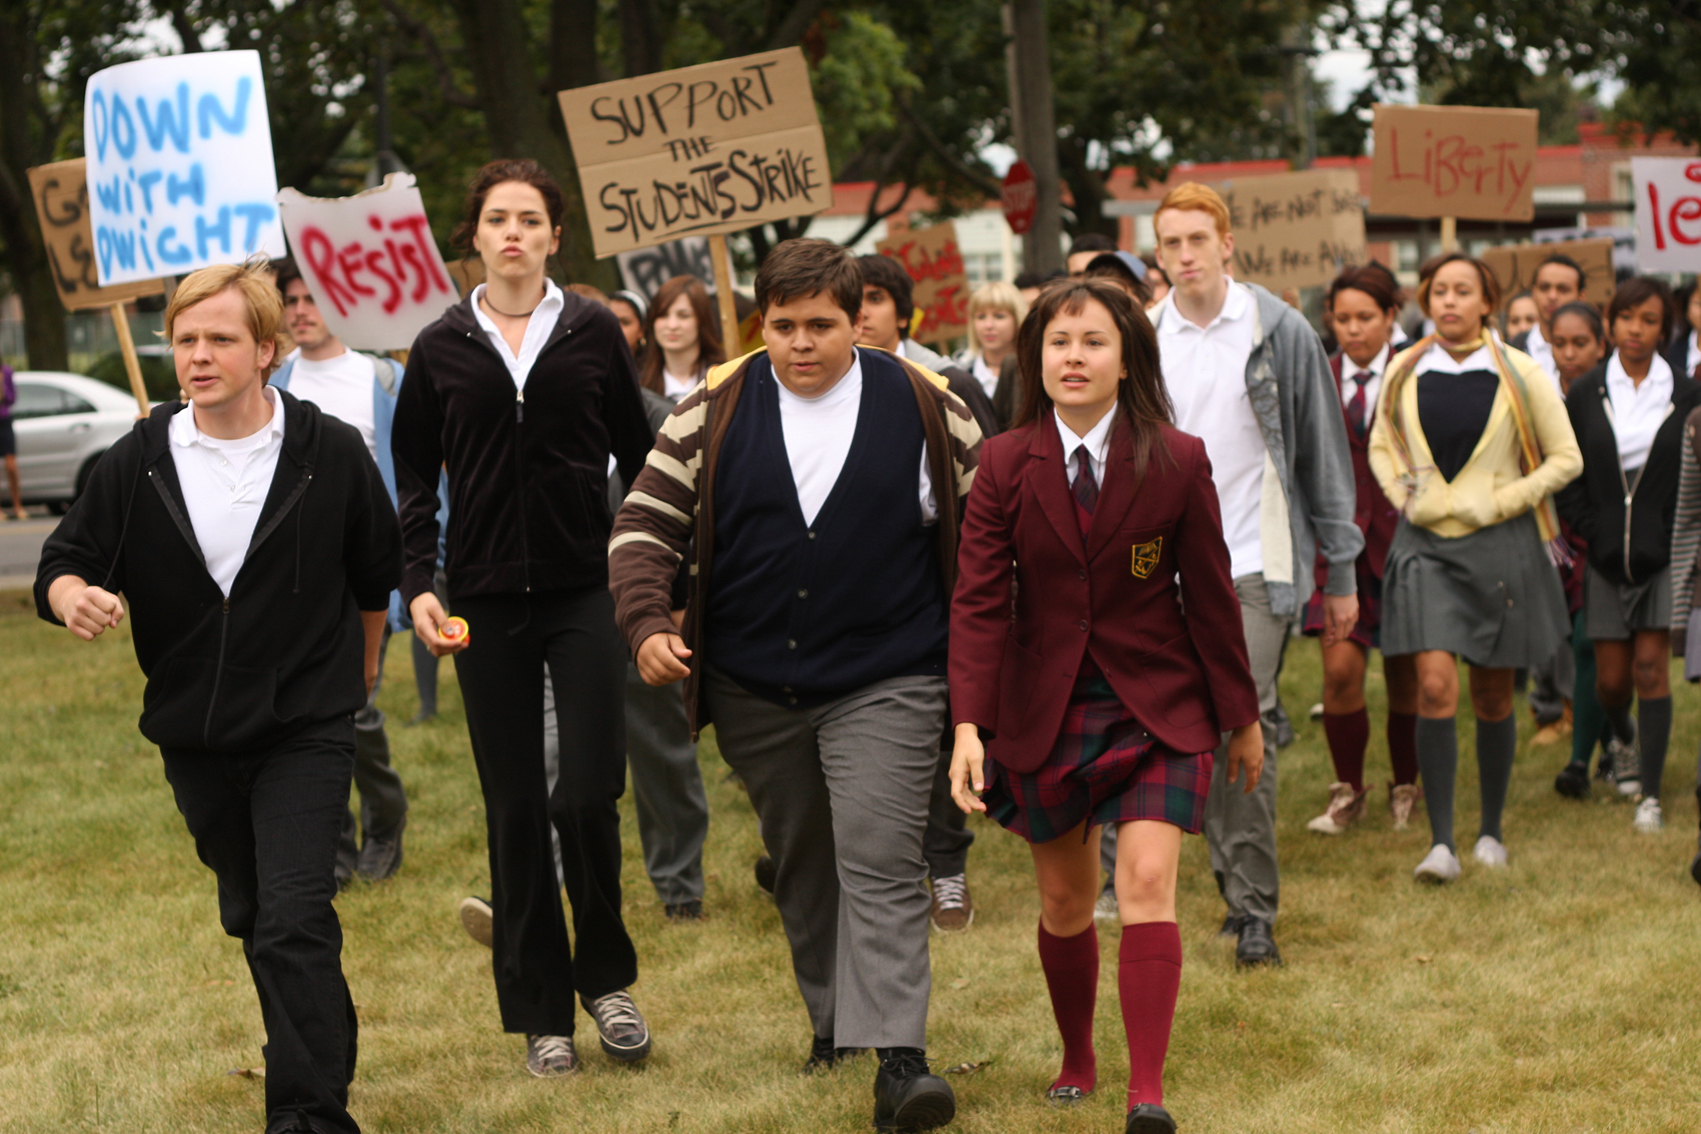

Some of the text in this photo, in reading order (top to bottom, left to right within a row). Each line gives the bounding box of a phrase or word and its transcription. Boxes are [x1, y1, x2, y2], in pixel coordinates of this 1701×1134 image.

[92, 75, 252, 163] DOWN
[590, 60, 779, 145] SUPPORT
[663, 136, 718, 162] THE
[599, 161, 737, 243] STUDENTS
